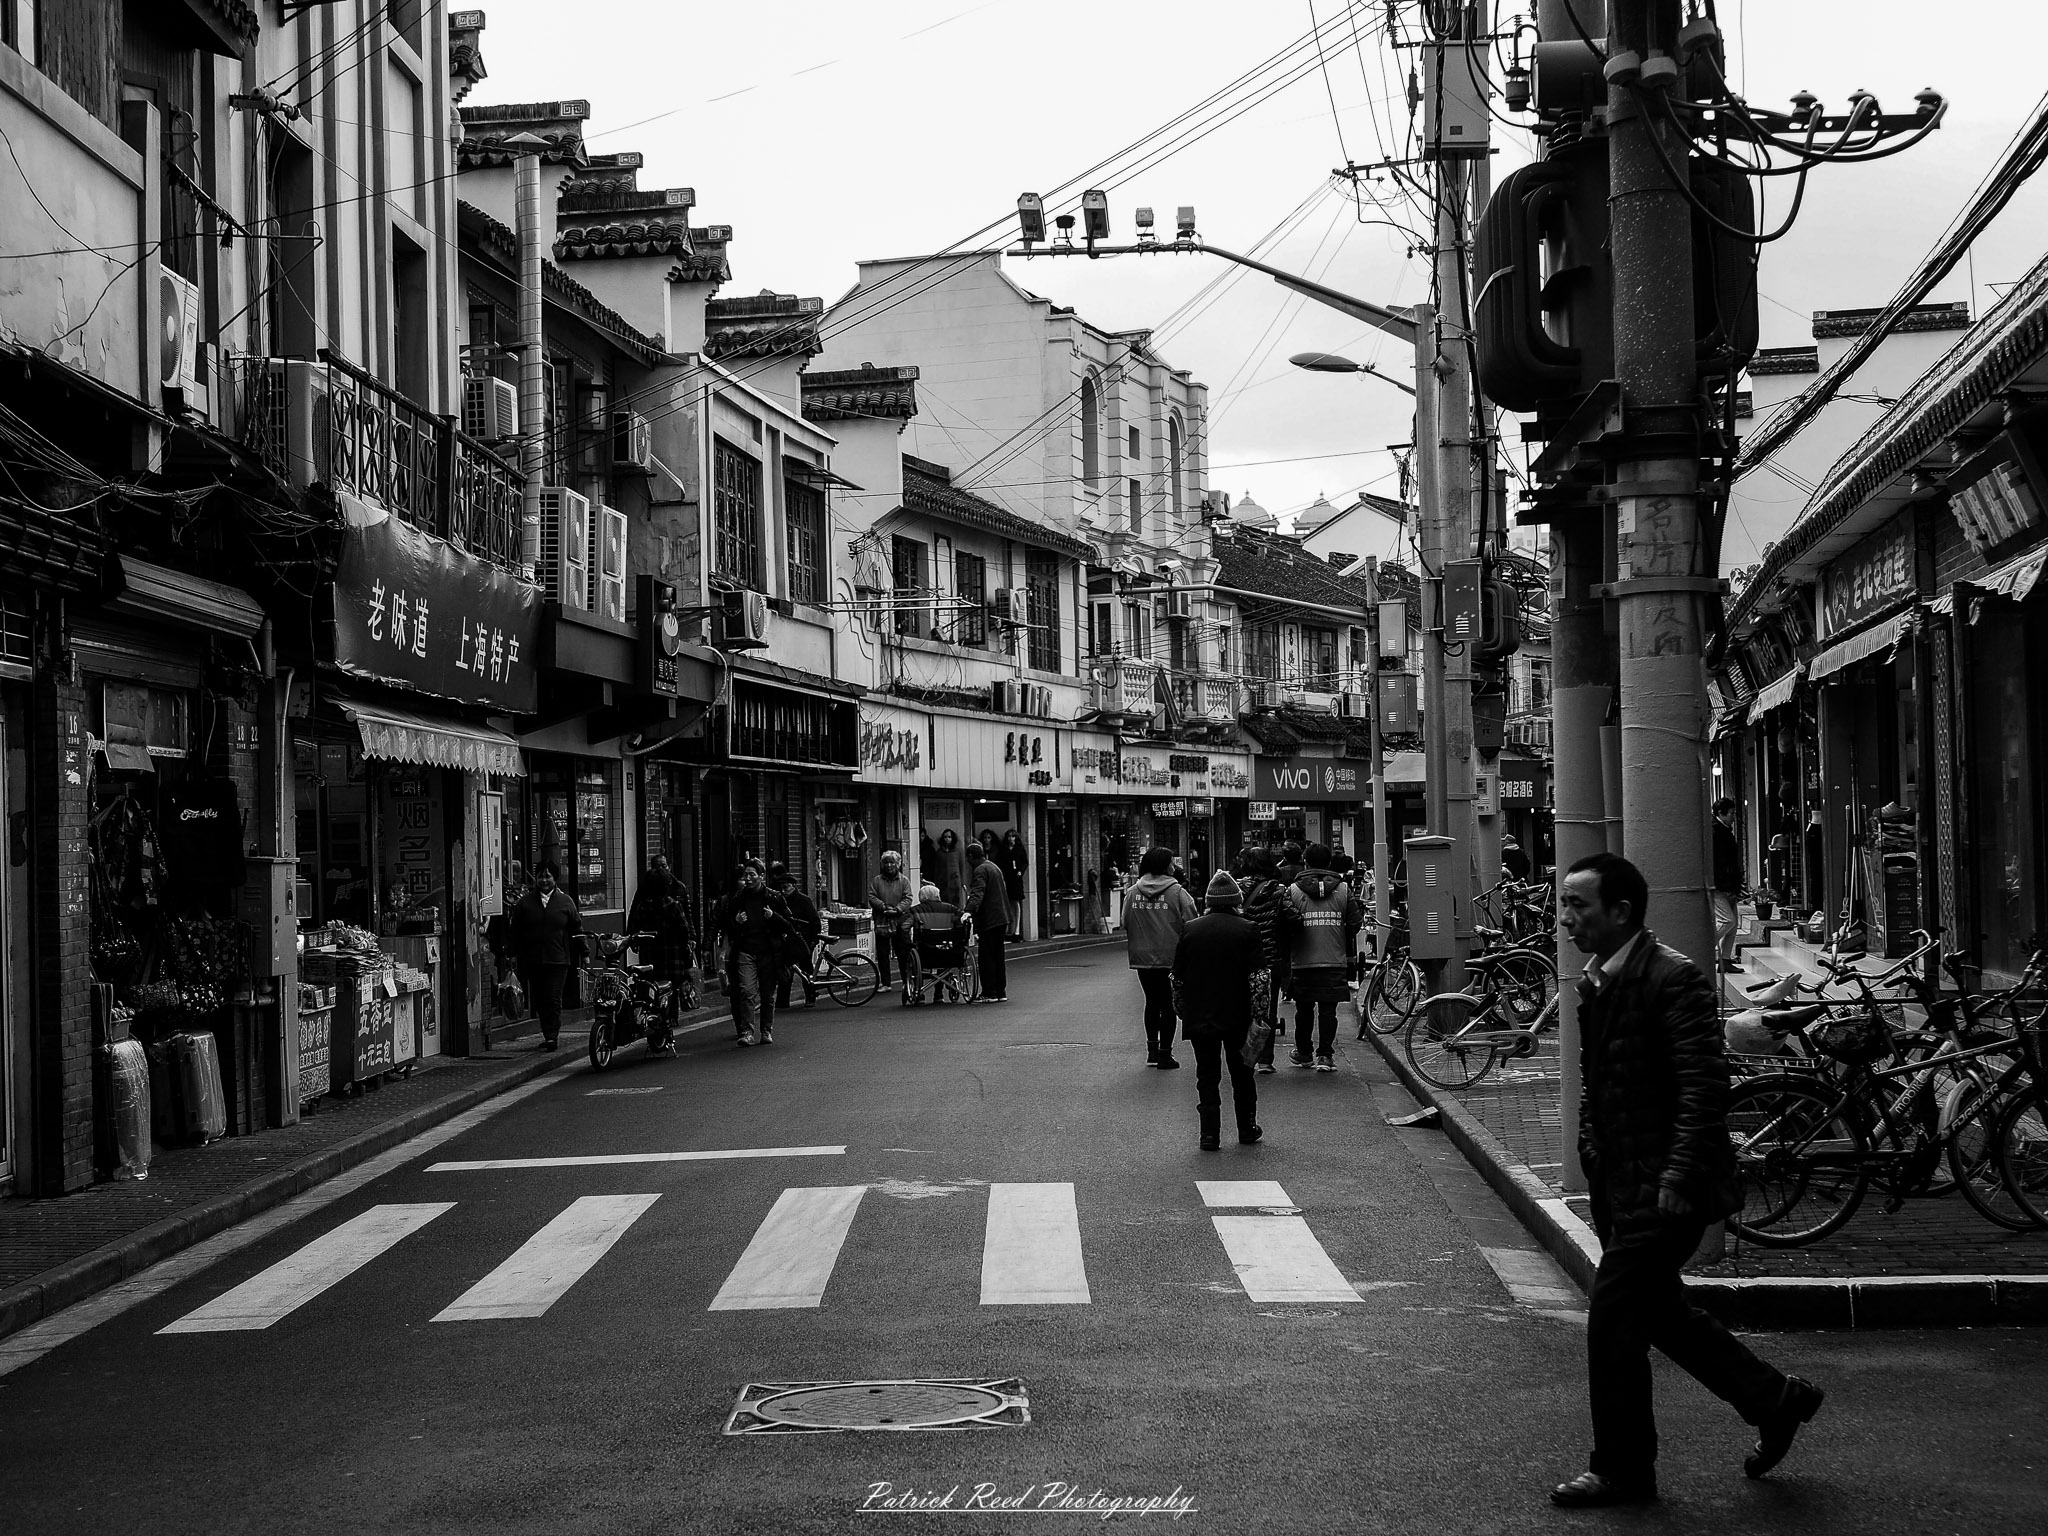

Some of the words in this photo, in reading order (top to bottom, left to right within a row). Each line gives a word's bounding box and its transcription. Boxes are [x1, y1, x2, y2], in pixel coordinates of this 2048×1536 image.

[1854, 535, 1906, 610] 老北京布鞋
[368, 578, 429, 659] 老味道
[456, 616, 520, 684] 上海特产
[69, 715, 78, 734] 16
[237, 725, 245, 741] 18
[1273, 762, 1310, 790] vivo
[1336, 769, 1356, 781] 中国移动
[1500, 781, 1533, 797] 名烟名酒店
[1302, 911, 1342, 919] 困难找志愿者
[358, 998, 393, 1038] 五香豆
[358, 1039, 392, 1072] 十元三包
